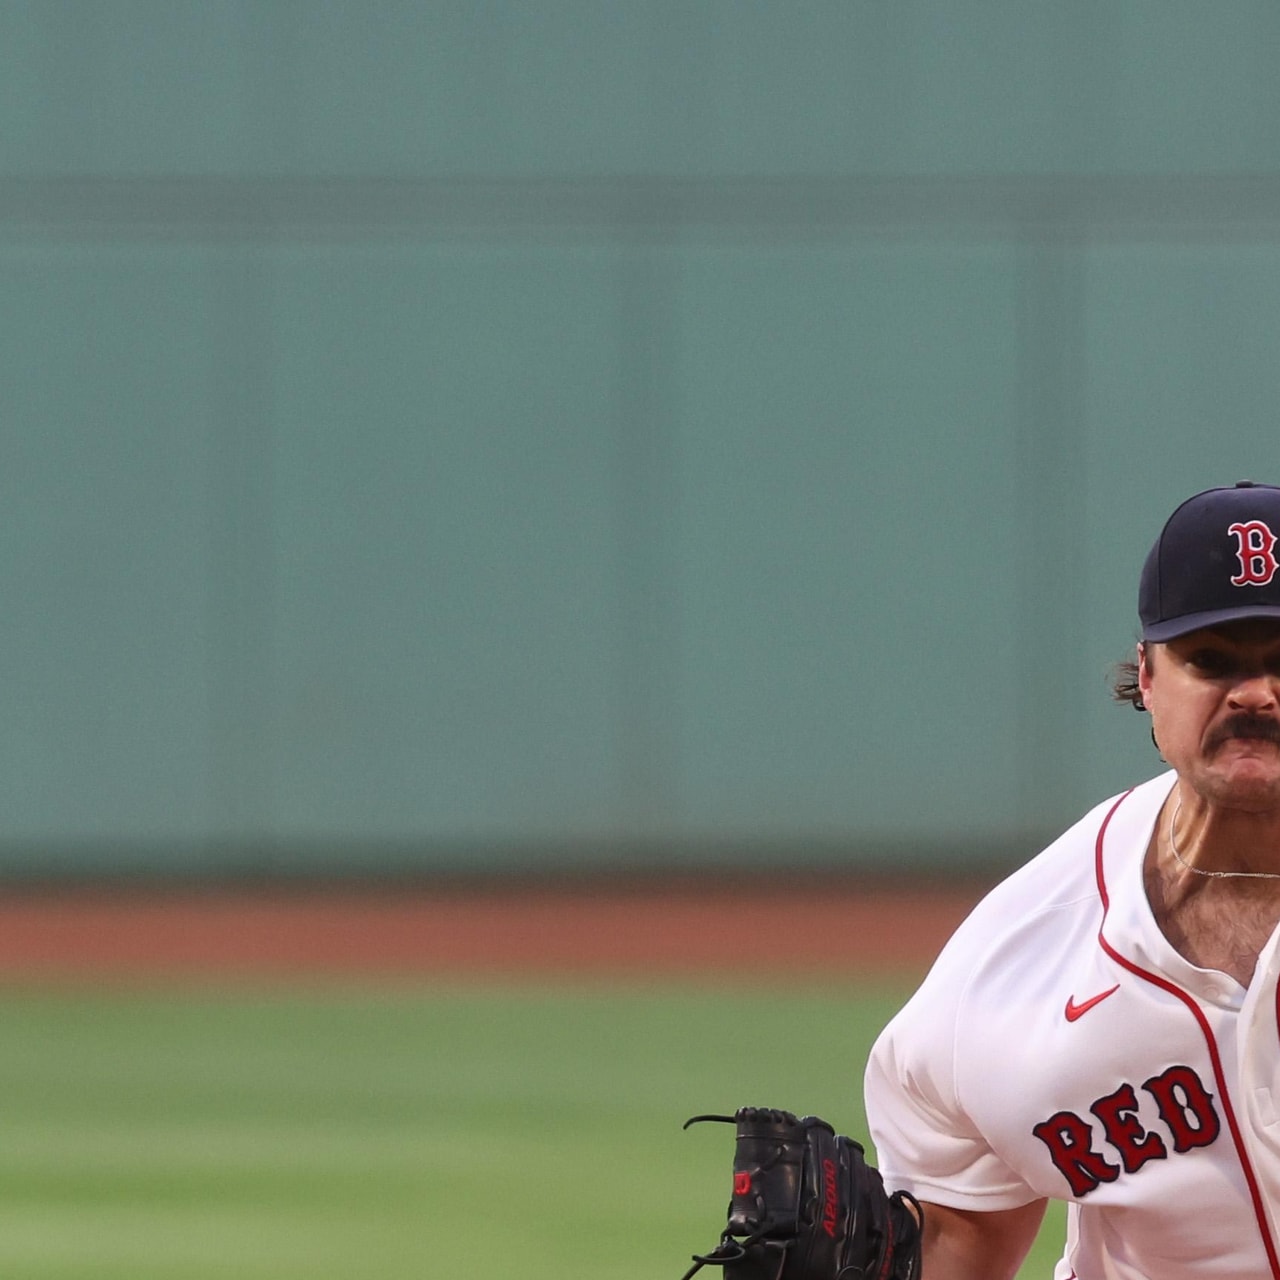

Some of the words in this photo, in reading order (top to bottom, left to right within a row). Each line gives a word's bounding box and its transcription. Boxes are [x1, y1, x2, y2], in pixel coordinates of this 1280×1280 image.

[1227, 519, 1280, 587] B
[1032, 1064, 1221, 1198] RED
[822, 1158, 838, 1238] A2000
